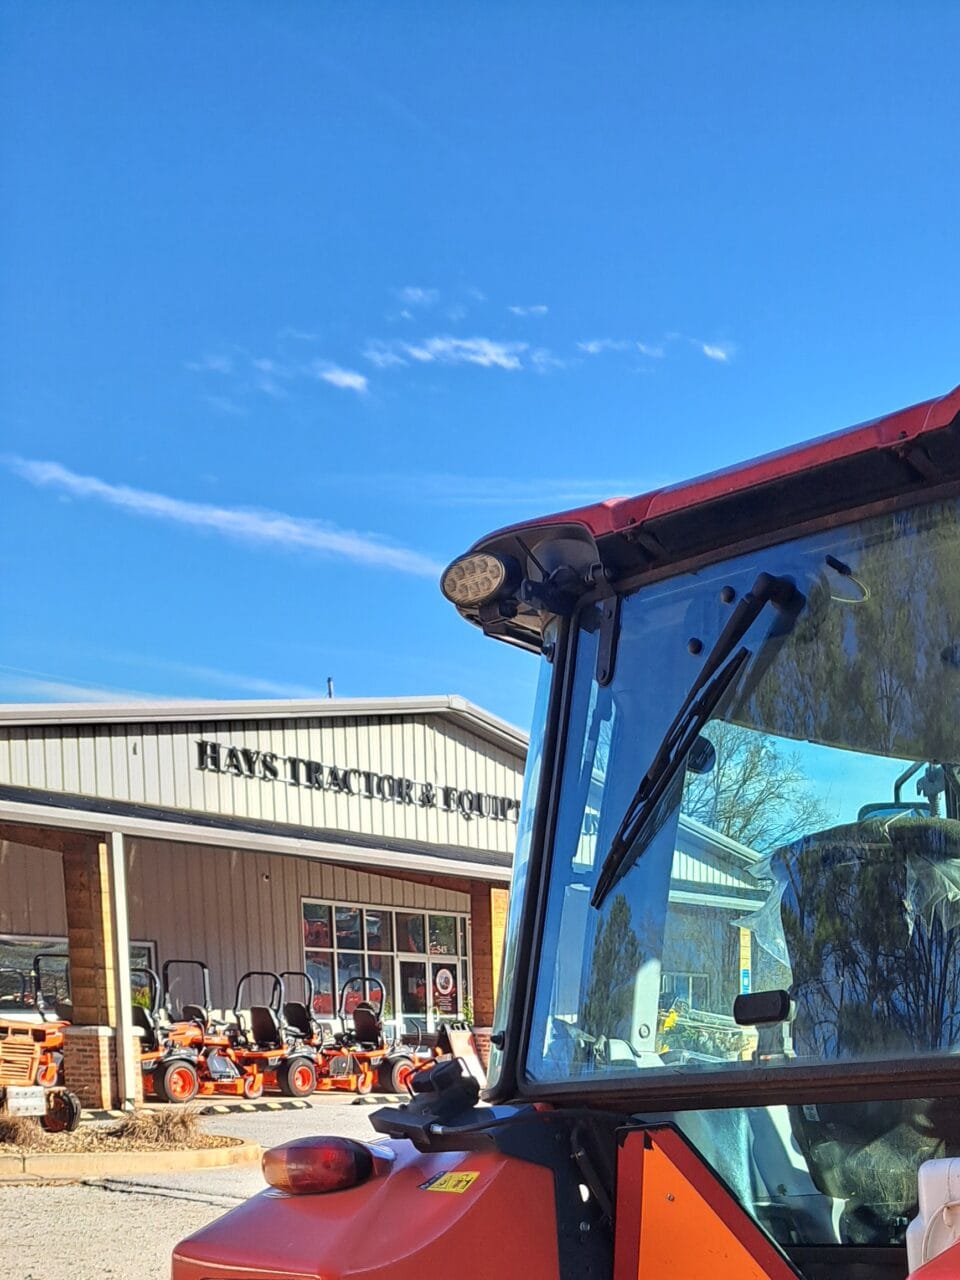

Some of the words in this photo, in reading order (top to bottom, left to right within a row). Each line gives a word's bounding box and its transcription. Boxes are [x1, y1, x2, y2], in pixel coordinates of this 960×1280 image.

[194, 740, 279, 782] HAYS
[284, 755, 415, 805] TRACTOR
[415, 782, 436, 807] &
